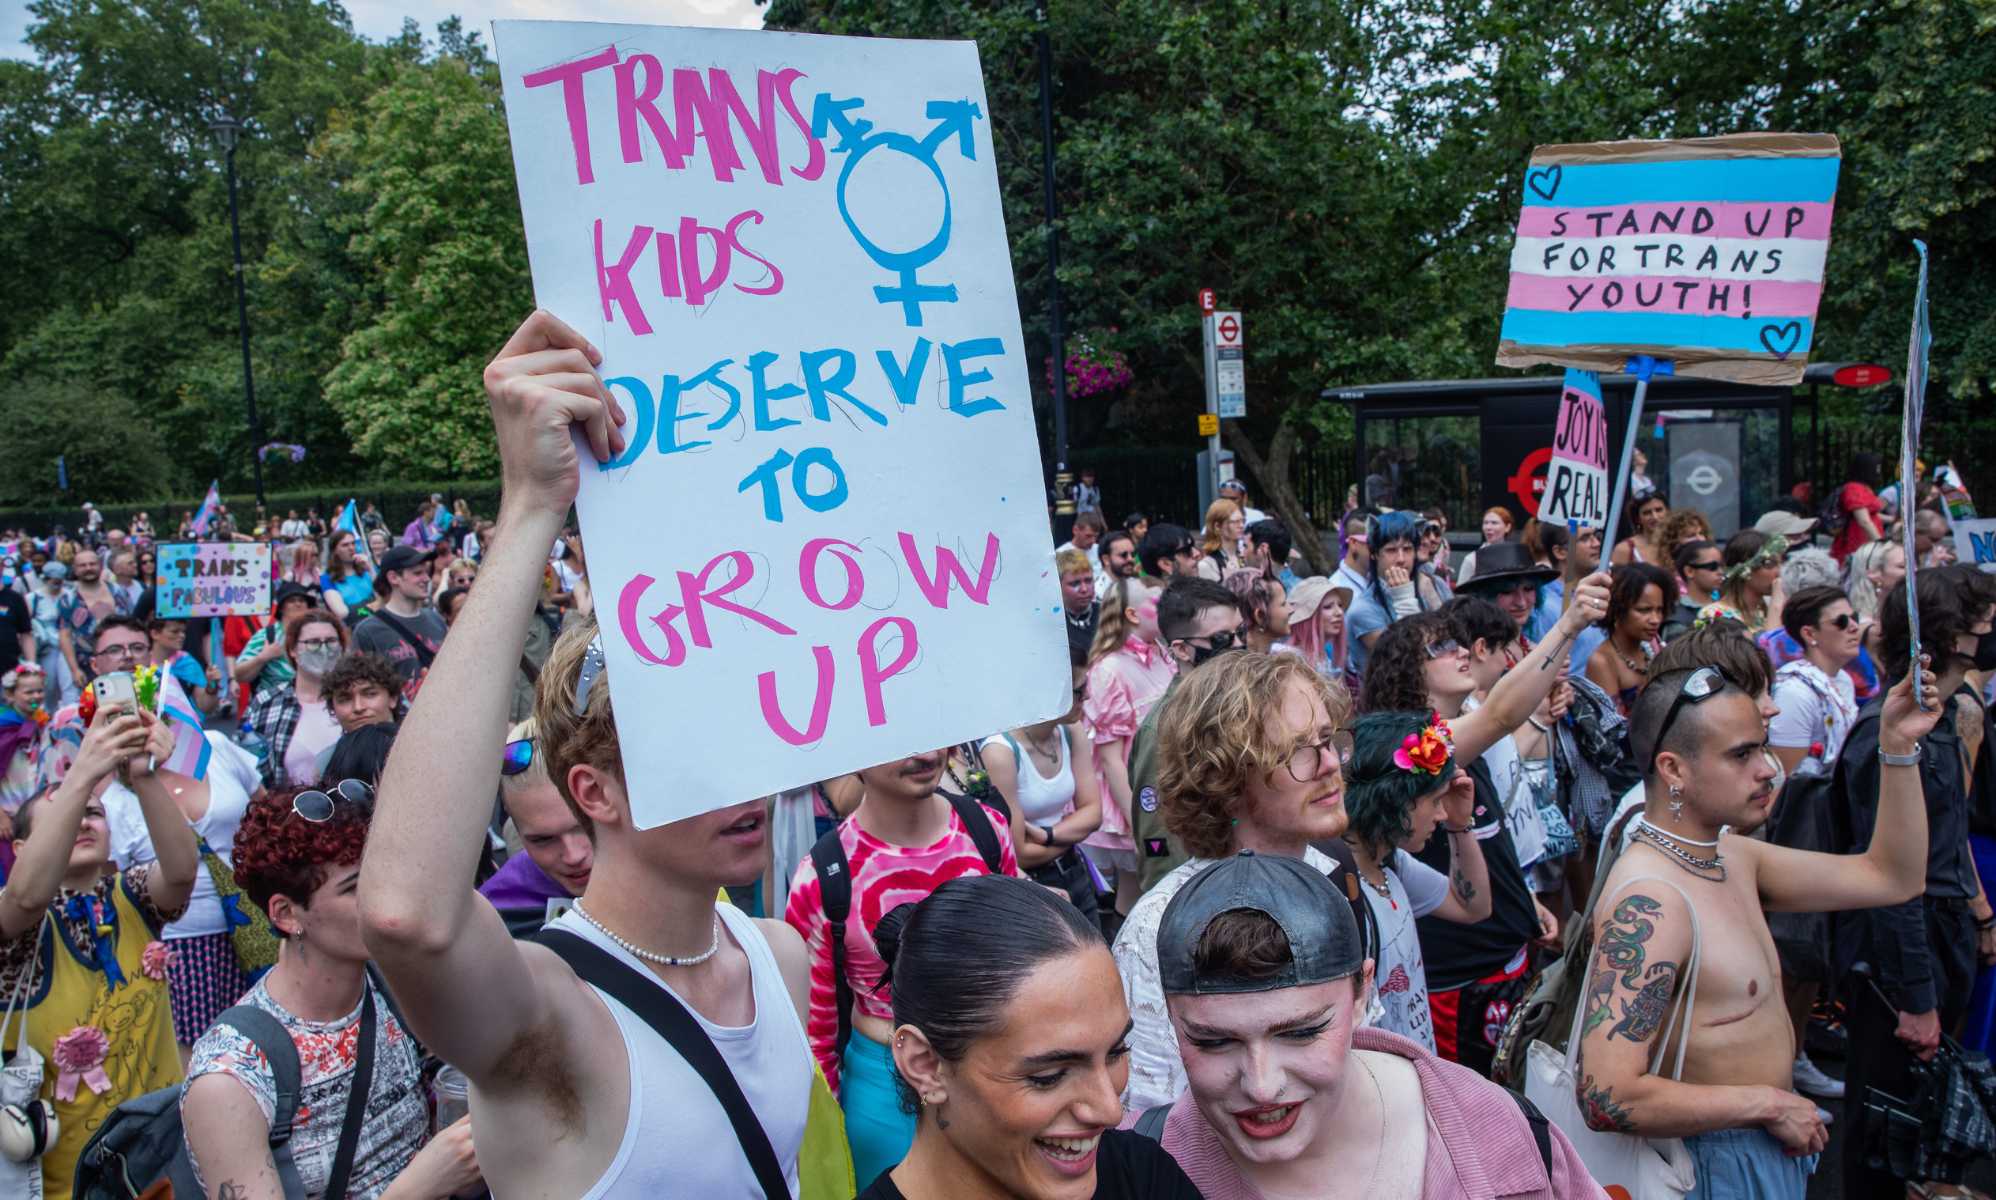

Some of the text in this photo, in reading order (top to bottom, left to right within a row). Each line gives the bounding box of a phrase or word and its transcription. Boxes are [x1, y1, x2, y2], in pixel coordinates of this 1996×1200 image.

[523, 45, 826, 186] TRANS
[1550, 206, 1805, 239] STAND UP
[593, 209, 784, 336] KIDS
[1543, 242, 1783, 274] FOR TRANS
[1204, 292, 1213, 309] E
[1567, 280, 1752, 320] YOUTH!
[598, 337, 1006, 472] DESERVE
[1557, 392, 1594, 457] JOY
[738, 446, 849, 523] TO
[1548, 465, 1603, 521] REAL
[175, 558, 249, 578] TRANS
[1968, 530, 1996, 563] N
[171, 585, 256, 608] FABULOUS
[617, 530, 1000, 668] GROW
[757, 616, 919, 746] UP
